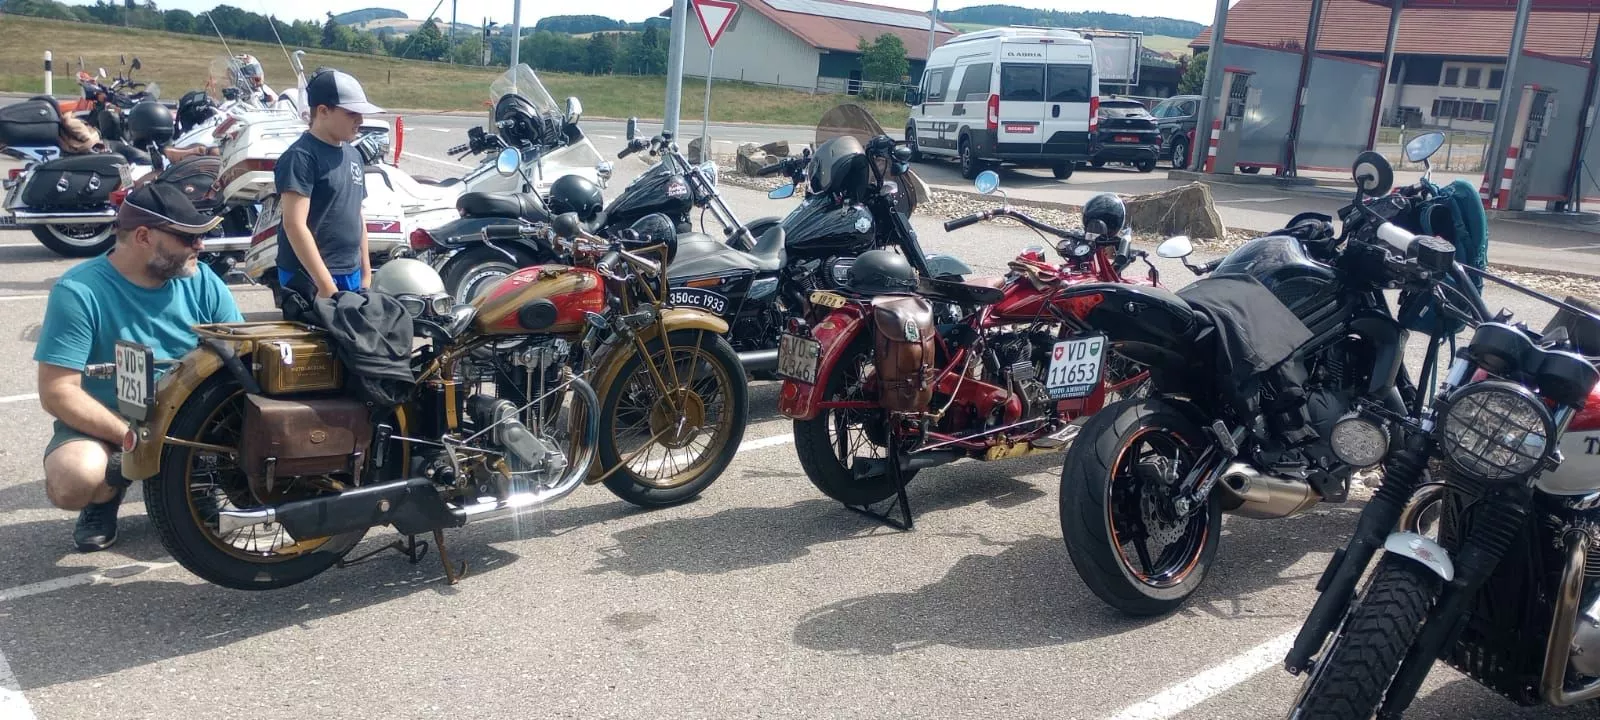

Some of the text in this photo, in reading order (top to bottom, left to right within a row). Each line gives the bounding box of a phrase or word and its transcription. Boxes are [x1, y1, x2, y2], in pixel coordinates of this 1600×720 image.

[670, 292, 724, 311] 350cc 1933
[818, 295, 837, 307] 1928
[792, 337, 806, 358] VD
[1068, 342, 1087, 361] VD
[124, 348, 136, 373] VD
[782, 357, 810, 380] 4346
[1051, 363, 1096, 385] 11653
[120, 375, 142, 404] 7251
[1584, 436, 1600, 455] T
